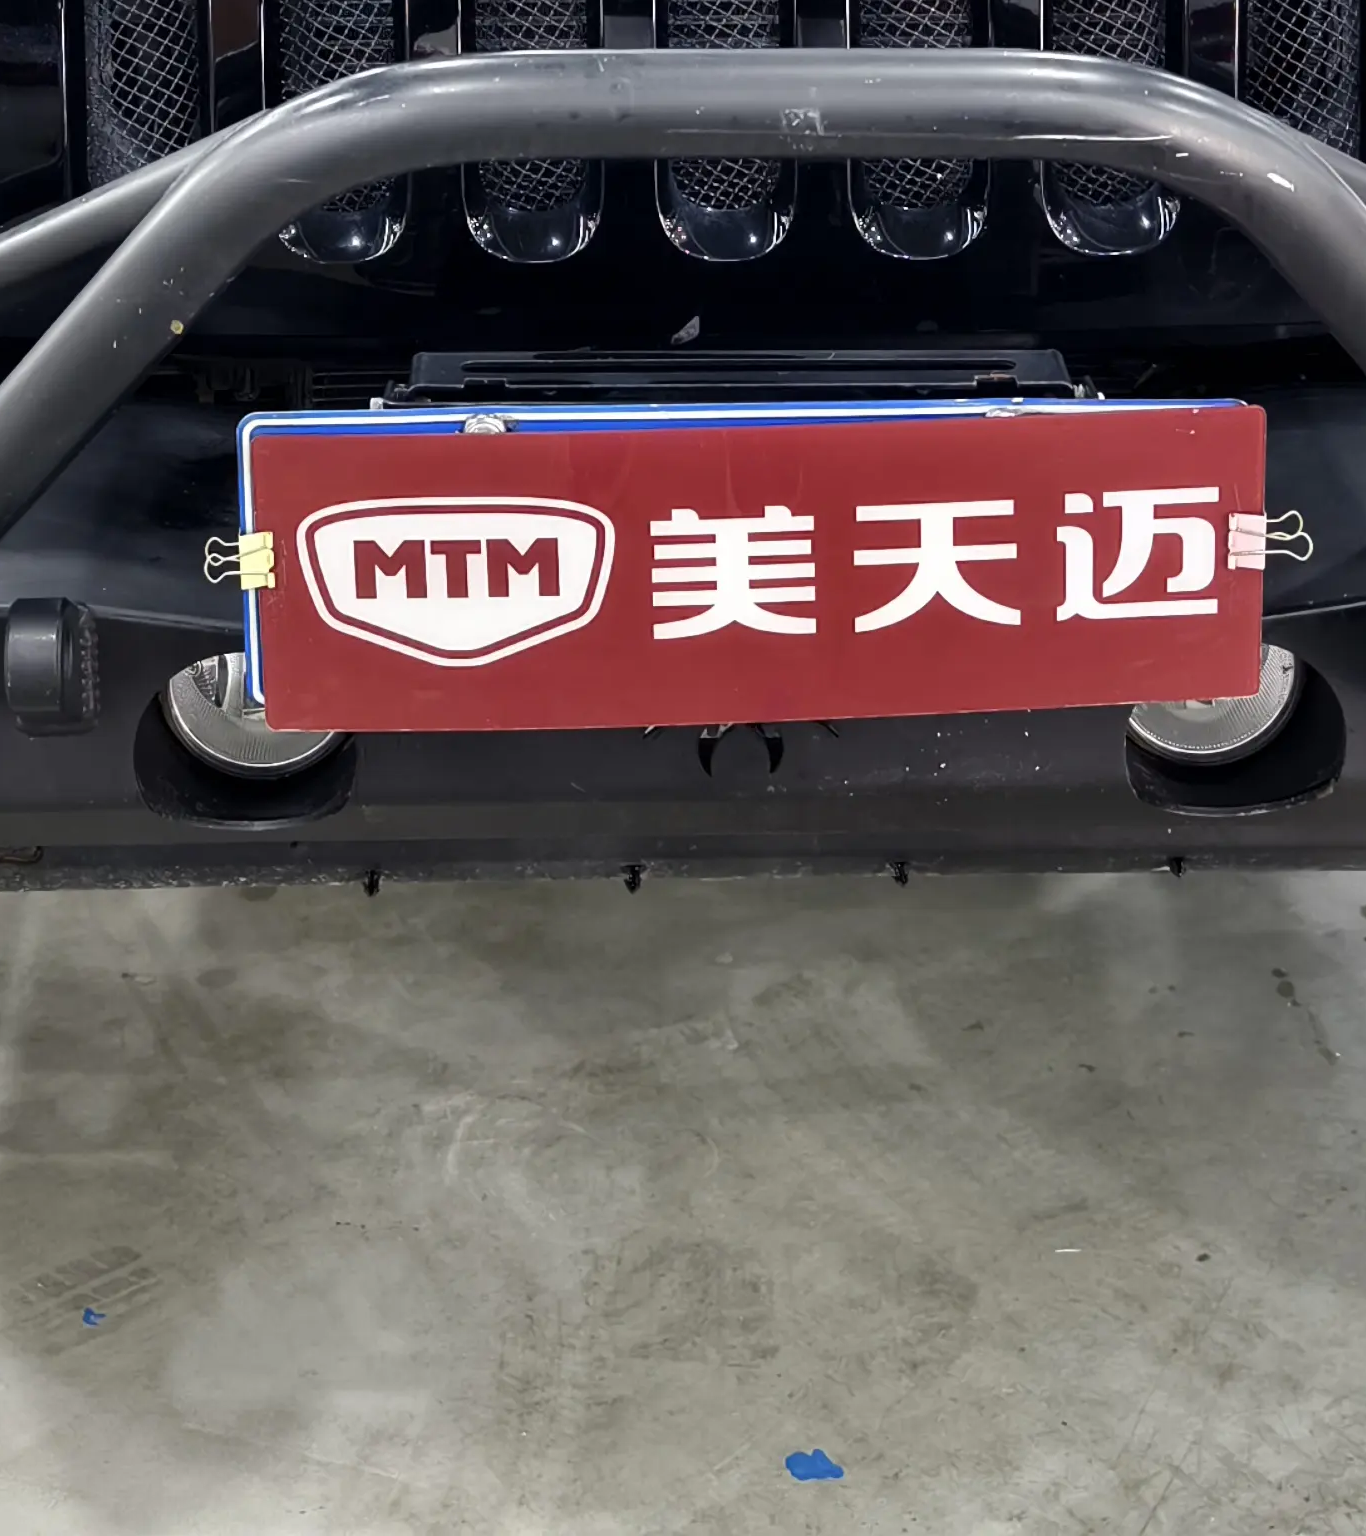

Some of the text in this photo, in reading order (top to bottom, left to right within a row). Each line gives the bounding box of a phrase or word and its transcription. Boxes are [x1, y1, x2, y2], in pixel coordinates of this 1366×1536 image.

[353, 486, 1220, 640] MTM 美天迈
